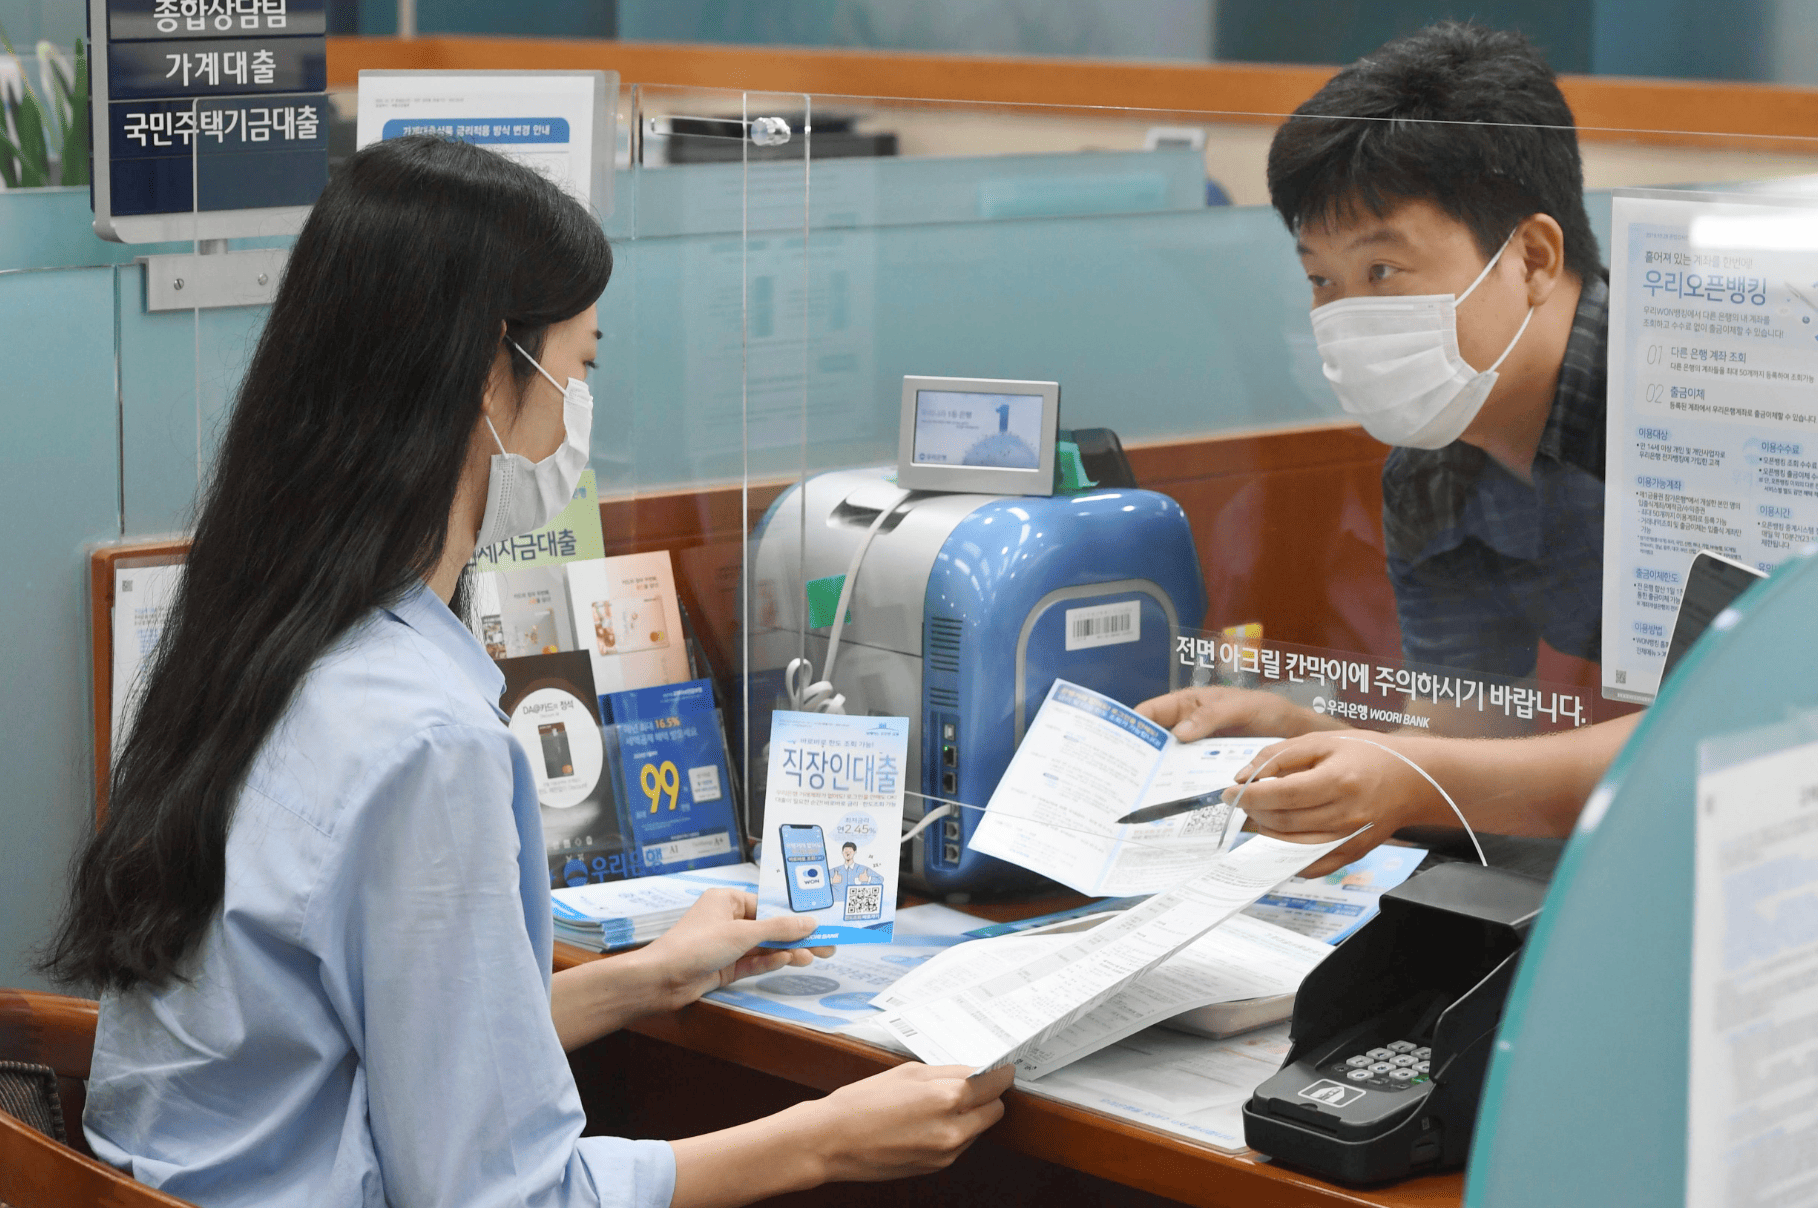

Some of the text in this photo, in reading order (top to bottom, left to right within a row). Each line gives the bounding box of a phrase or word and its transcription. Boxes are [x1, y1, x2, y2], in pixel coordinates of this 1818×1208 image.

[165, 49, 276, 87] 가계대출
[123, 105, 319, 146] 국민주택기금대출
[1673, 252, 1691, 266] 있는
[1693, 254, 1720, 268] 계좌를
[1643, 270, 1767, 306] 우리오픈뱅킹
[1646, 344, 1663, 365] 01
[1670, 346, 1747, 364] 다른 은행 계좌 조회
[1645, 383, 1665, 404] 02
[1670, 385, 1706, 401] 출금이체
[1638, 427, 1668, 441] 이용대상
[1761, 441, 1800, 454] 이용수수료
[1637, 476, 1681, 491] 이용가능계좌
[1760, 505, 1790, 519] 이용시간
[468, 529, 577, 567] 세자금대출
[1176, 635, 1586, 727] 전면 아크릴 칸막이에 주의하시기 바랍니다.
[1327, 699, 1368, 720] 우리은행
[1370, 708, 1430, 728] WOORI BANK
[782, 748, 899, 794] 직장인대출
[640, 760, 680, 814] 99
